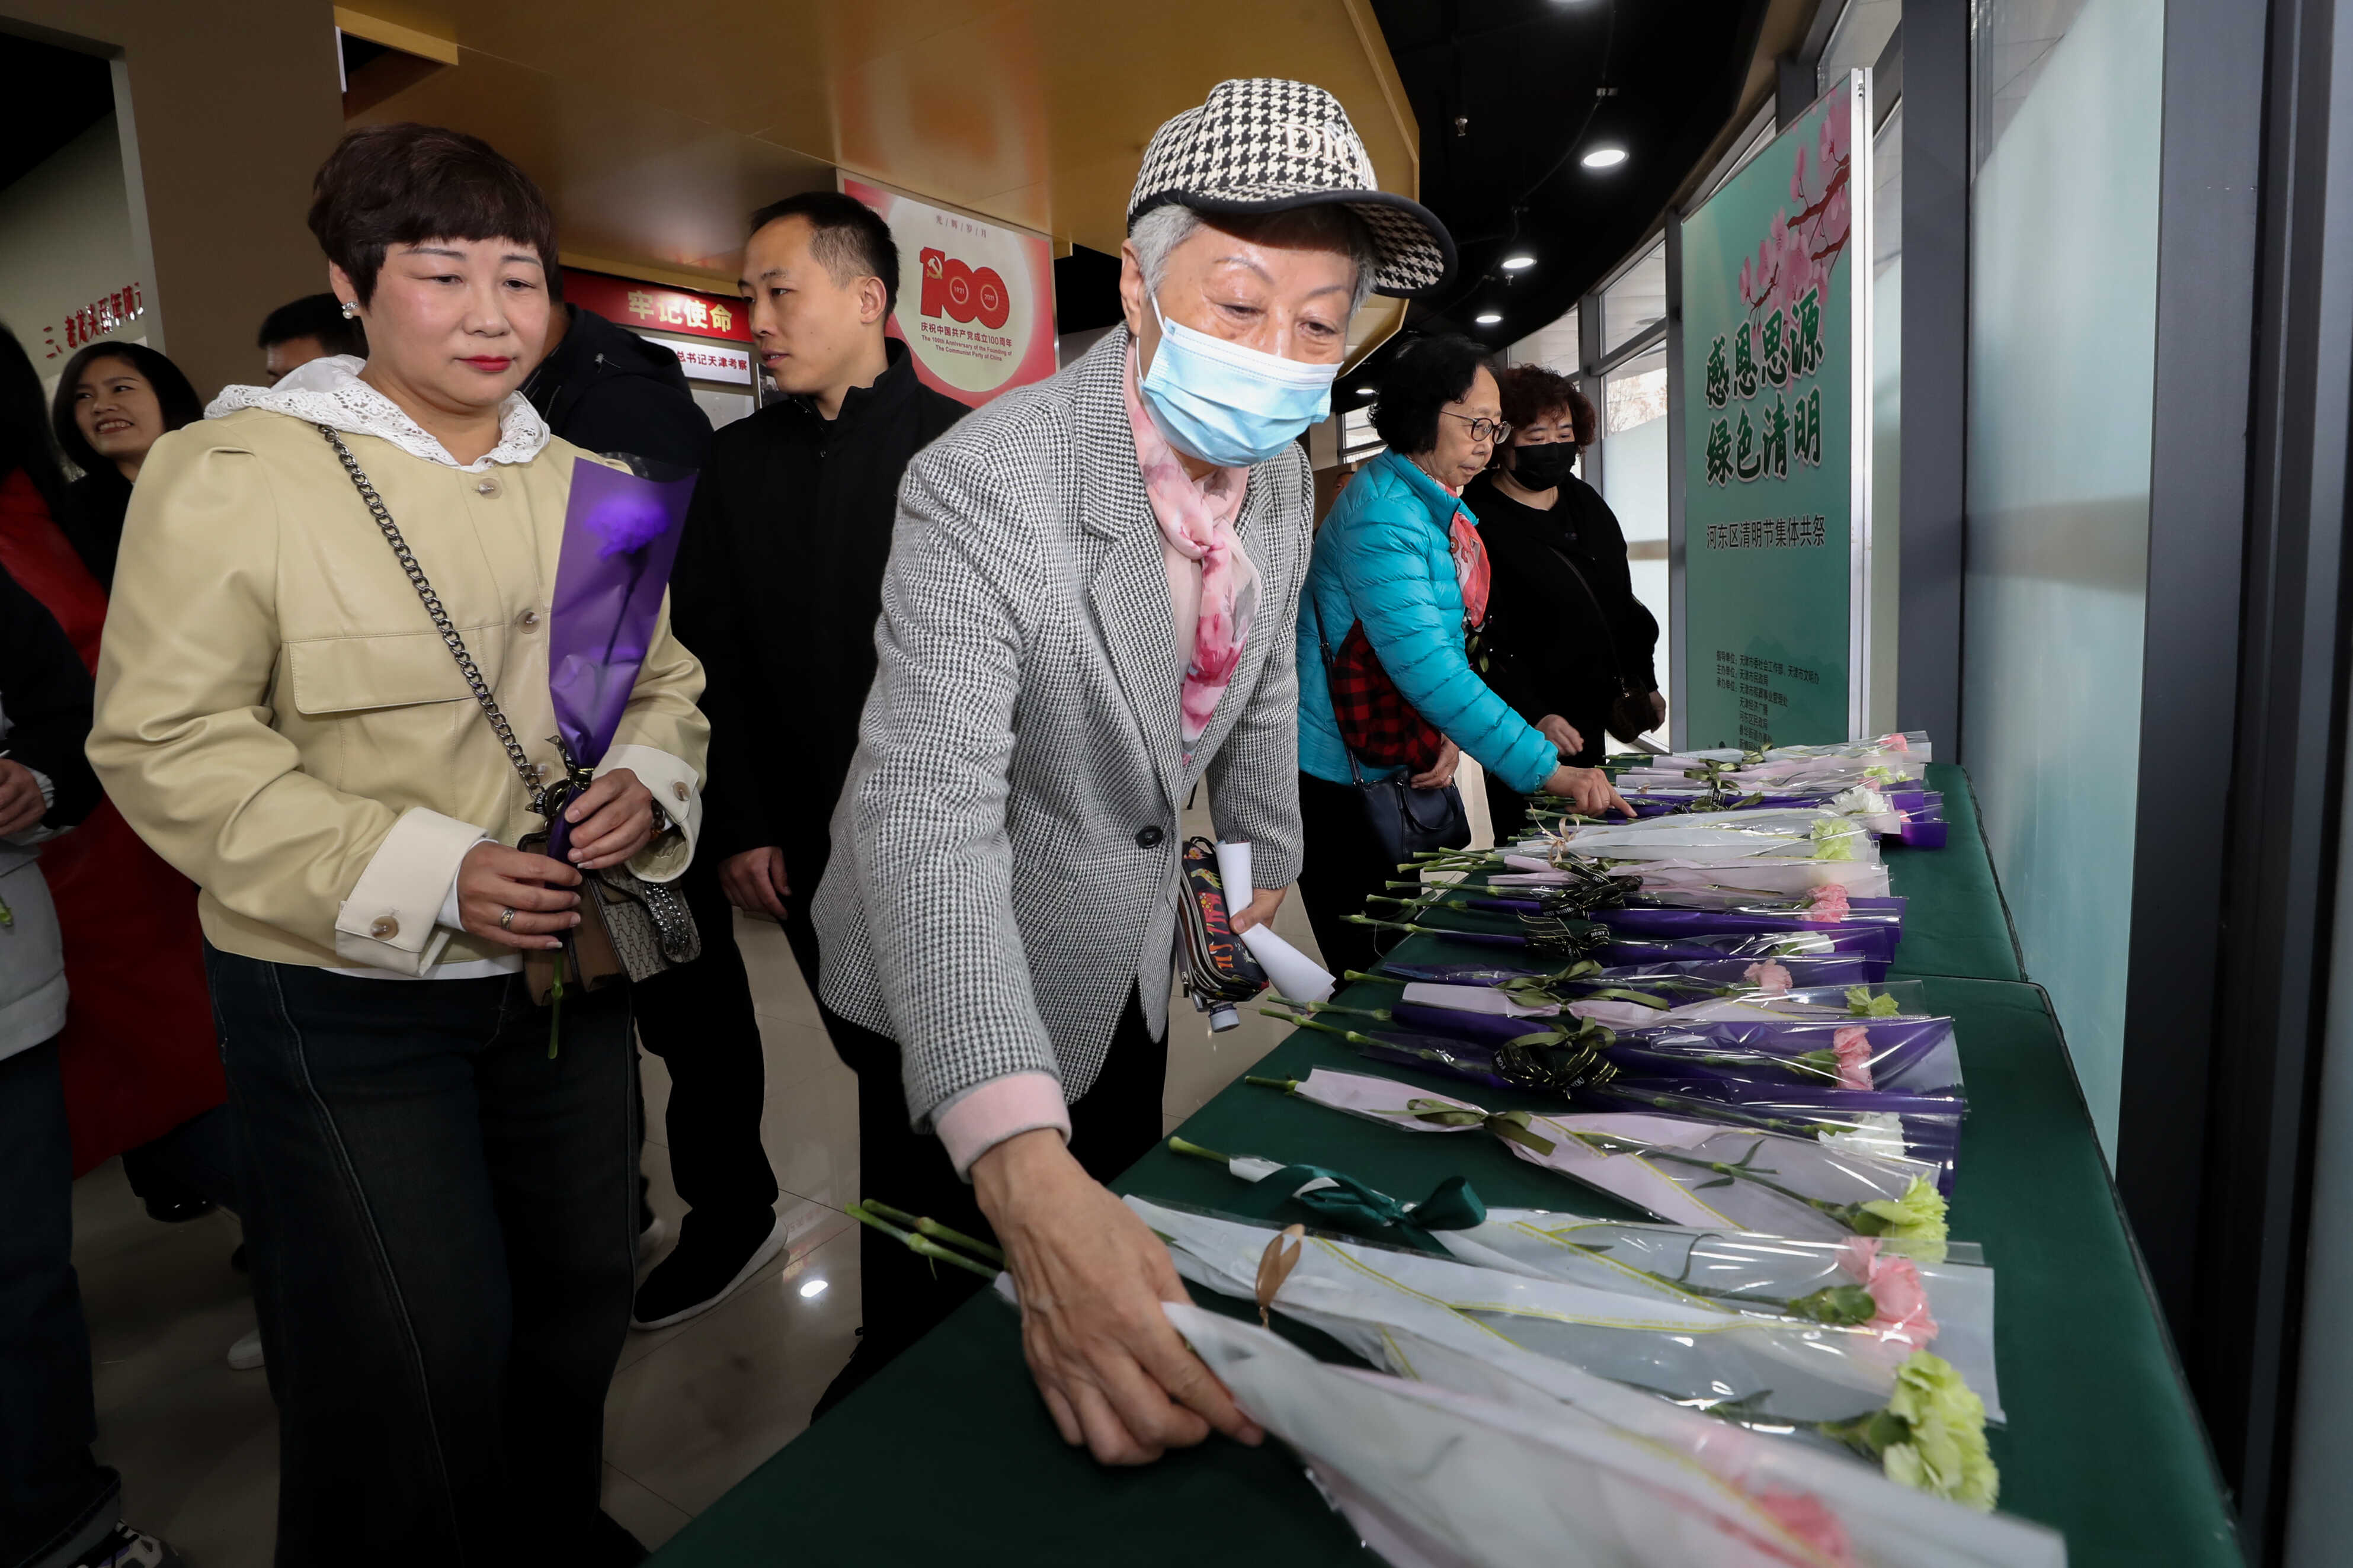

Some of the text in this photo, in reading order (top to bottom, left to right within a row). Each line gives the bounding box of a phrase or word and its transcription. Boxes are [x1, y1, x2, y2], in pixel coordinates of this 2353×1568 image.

[954, 286, 965, 294] 1921
[628, 290, 732, 332] 牢记使命
[921, 322, 1012, 347] 庆祝中国共产党成立100周年
[1706, 284, 1823, 409] 感恩思源
[946, 339, 973, 349] Anniversary
[987, 347, 1007, 356] Founding
[946, 347, 972, 356] Communist
[677, 351, 747, 371] 总书记天津考察
[1706, 386, 1821, 486] 绿色清明
[1707, 514, 1825, 550] 河东区清明节集体共祭
